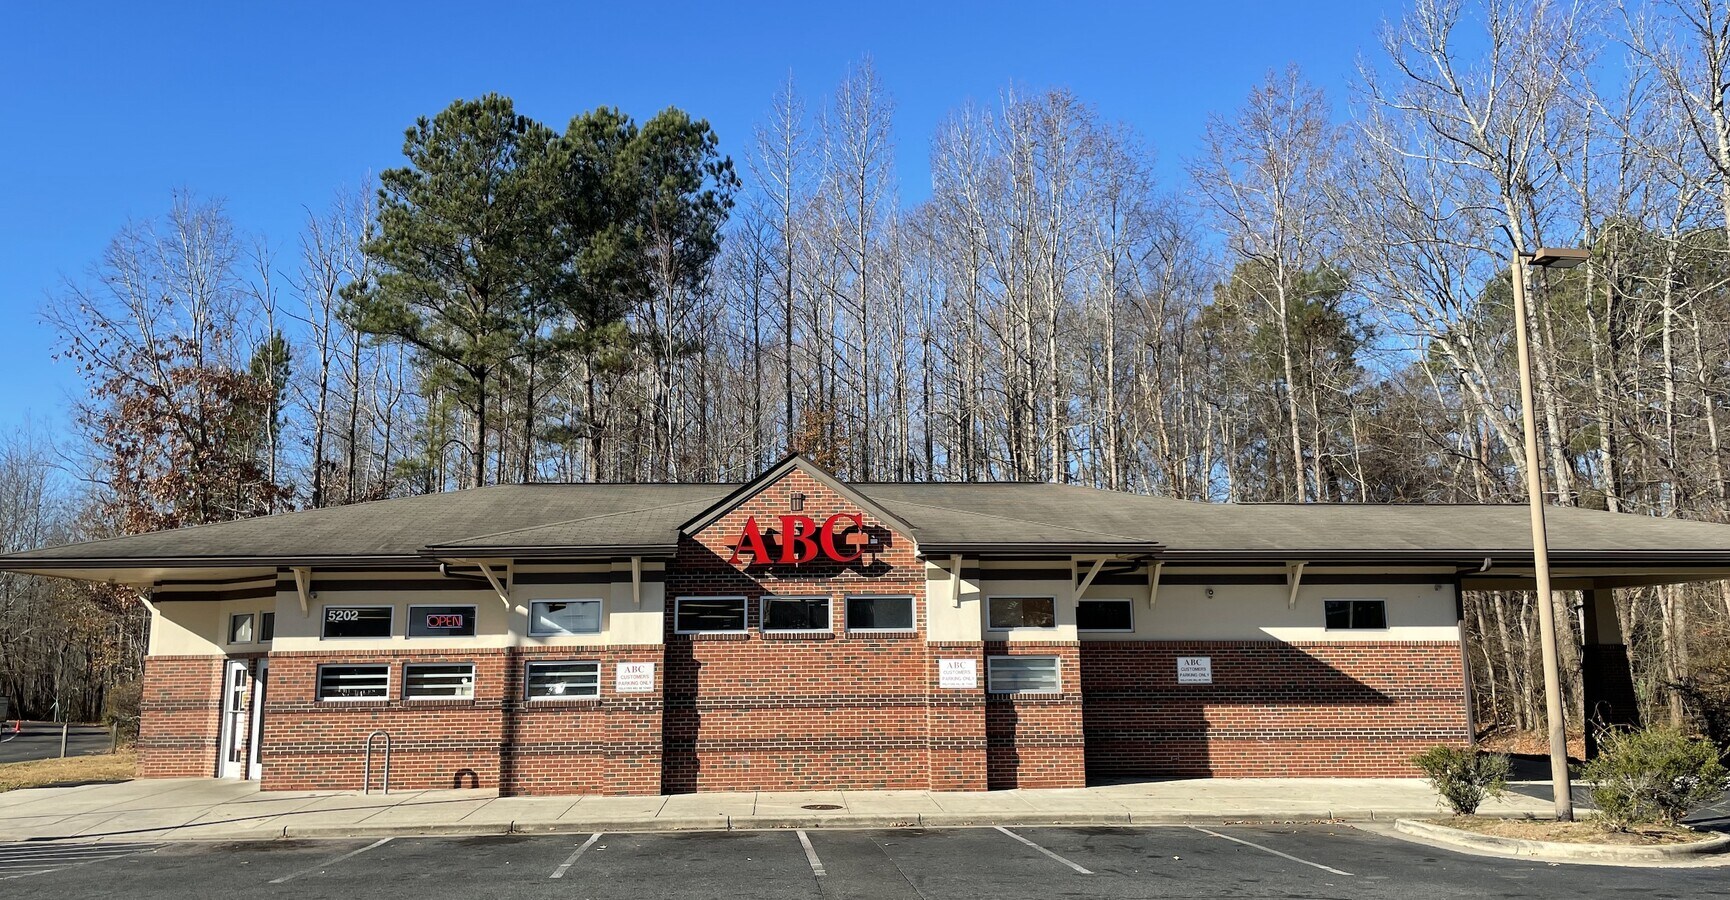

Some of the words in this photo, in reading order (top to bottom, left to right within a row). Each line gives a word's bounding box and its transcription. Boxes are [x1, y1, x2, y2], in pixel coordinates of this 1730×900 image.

[728, 513, 865, 564] ABC
[328, 610, 359, 621] 5202
[428, 615, 461, 627] OPEN
[624, 665, 645, 673] ABC
[947, 661, 967, 669] ABC
